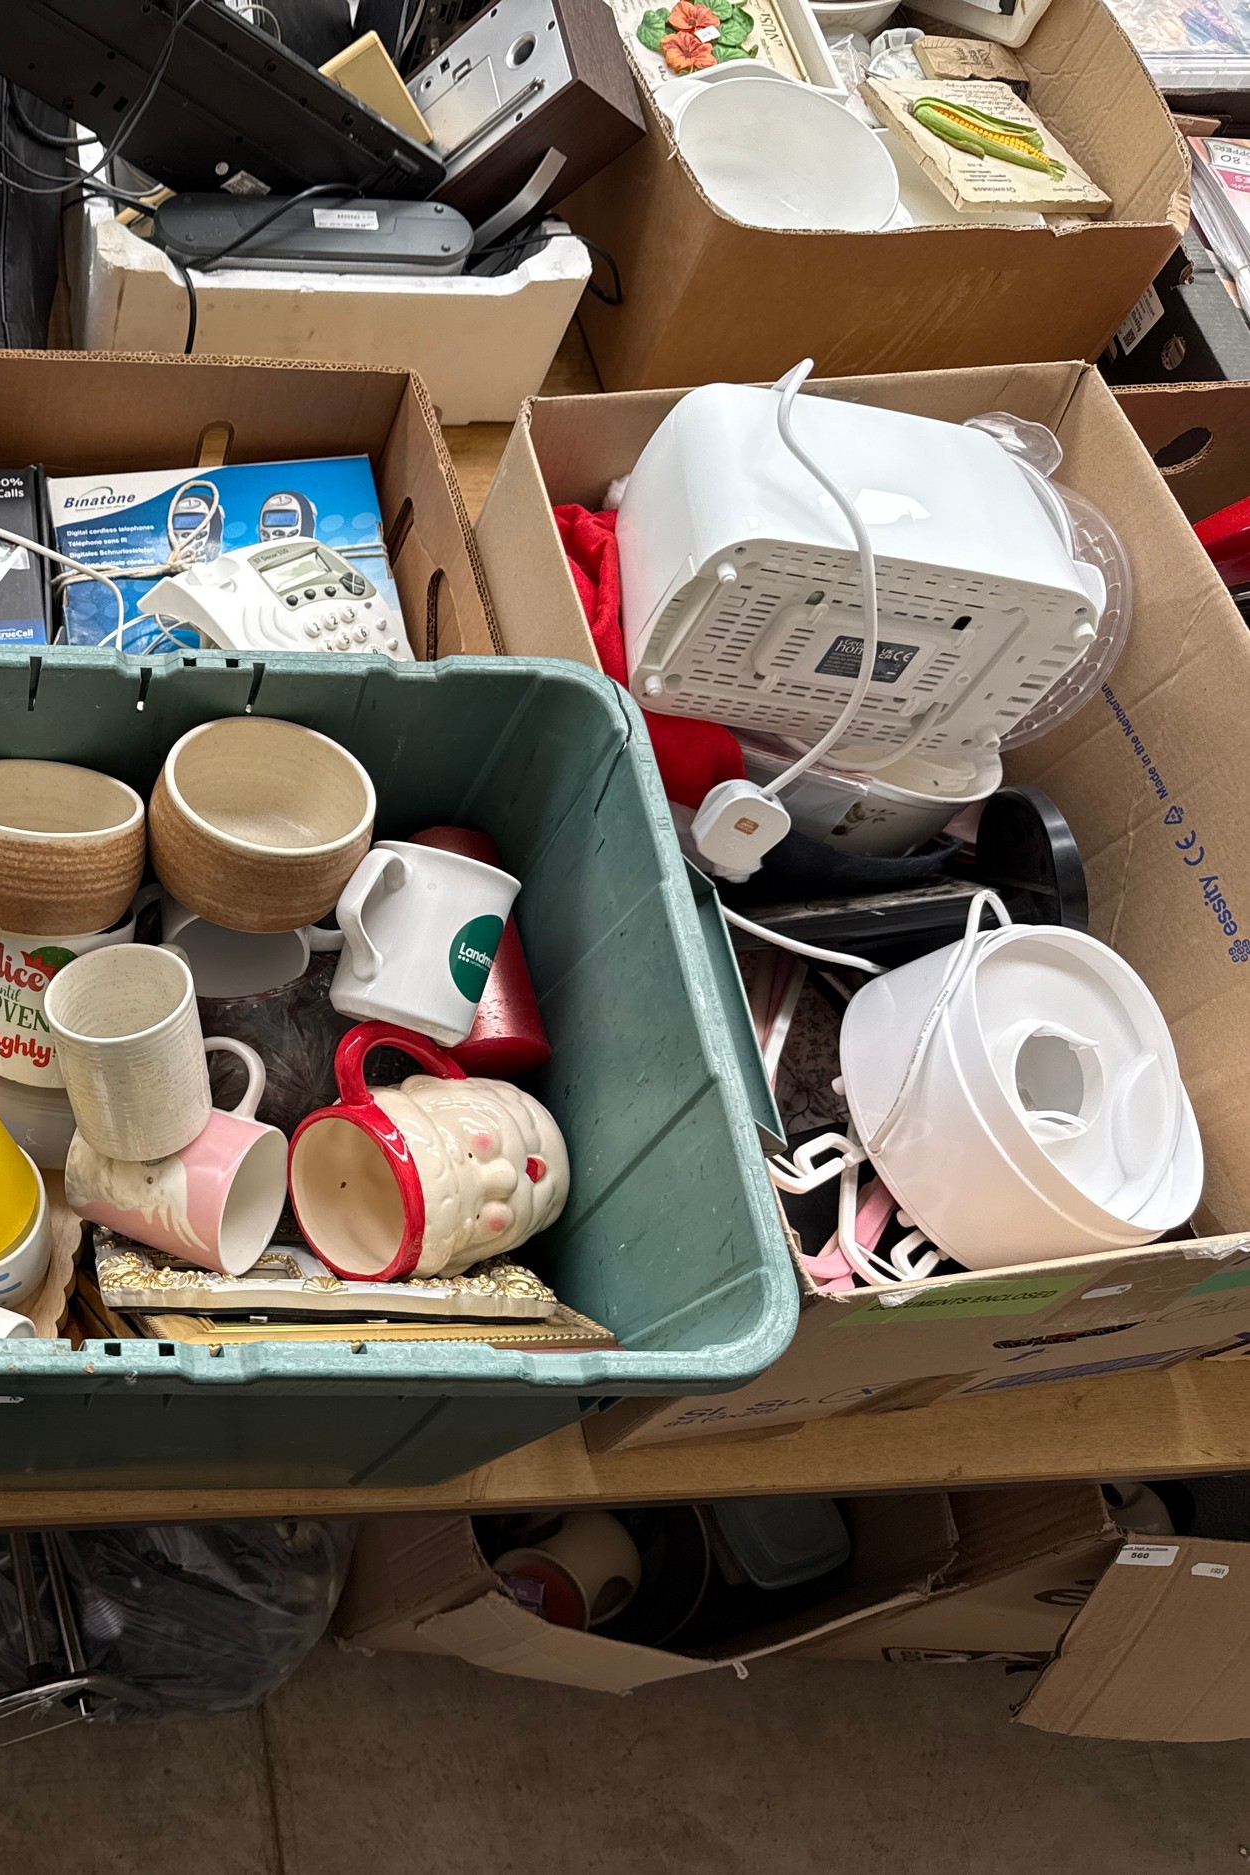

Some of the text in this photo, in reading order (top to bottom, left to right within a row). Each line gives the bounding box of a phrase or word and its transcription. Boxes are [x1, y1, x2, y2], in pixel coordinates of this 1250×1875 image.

[64, 494, 136, 509] Binatone
[66, 525, 155, 537] Digital cordless telephones
[69, 551, 98, 559] Digitales
[331, 616, 338, 625] 2
[313, 622, 321, 631] 1
[360, 628, 367, 638] 6
[343, 635, 350, 644] 5
[1101, 681, 1169, 800] Made in the Netherlan
[1199, 875, 1238, 937] essity
[868, 1289, 1059, 1312] DCUMENTS ENCLOSED
